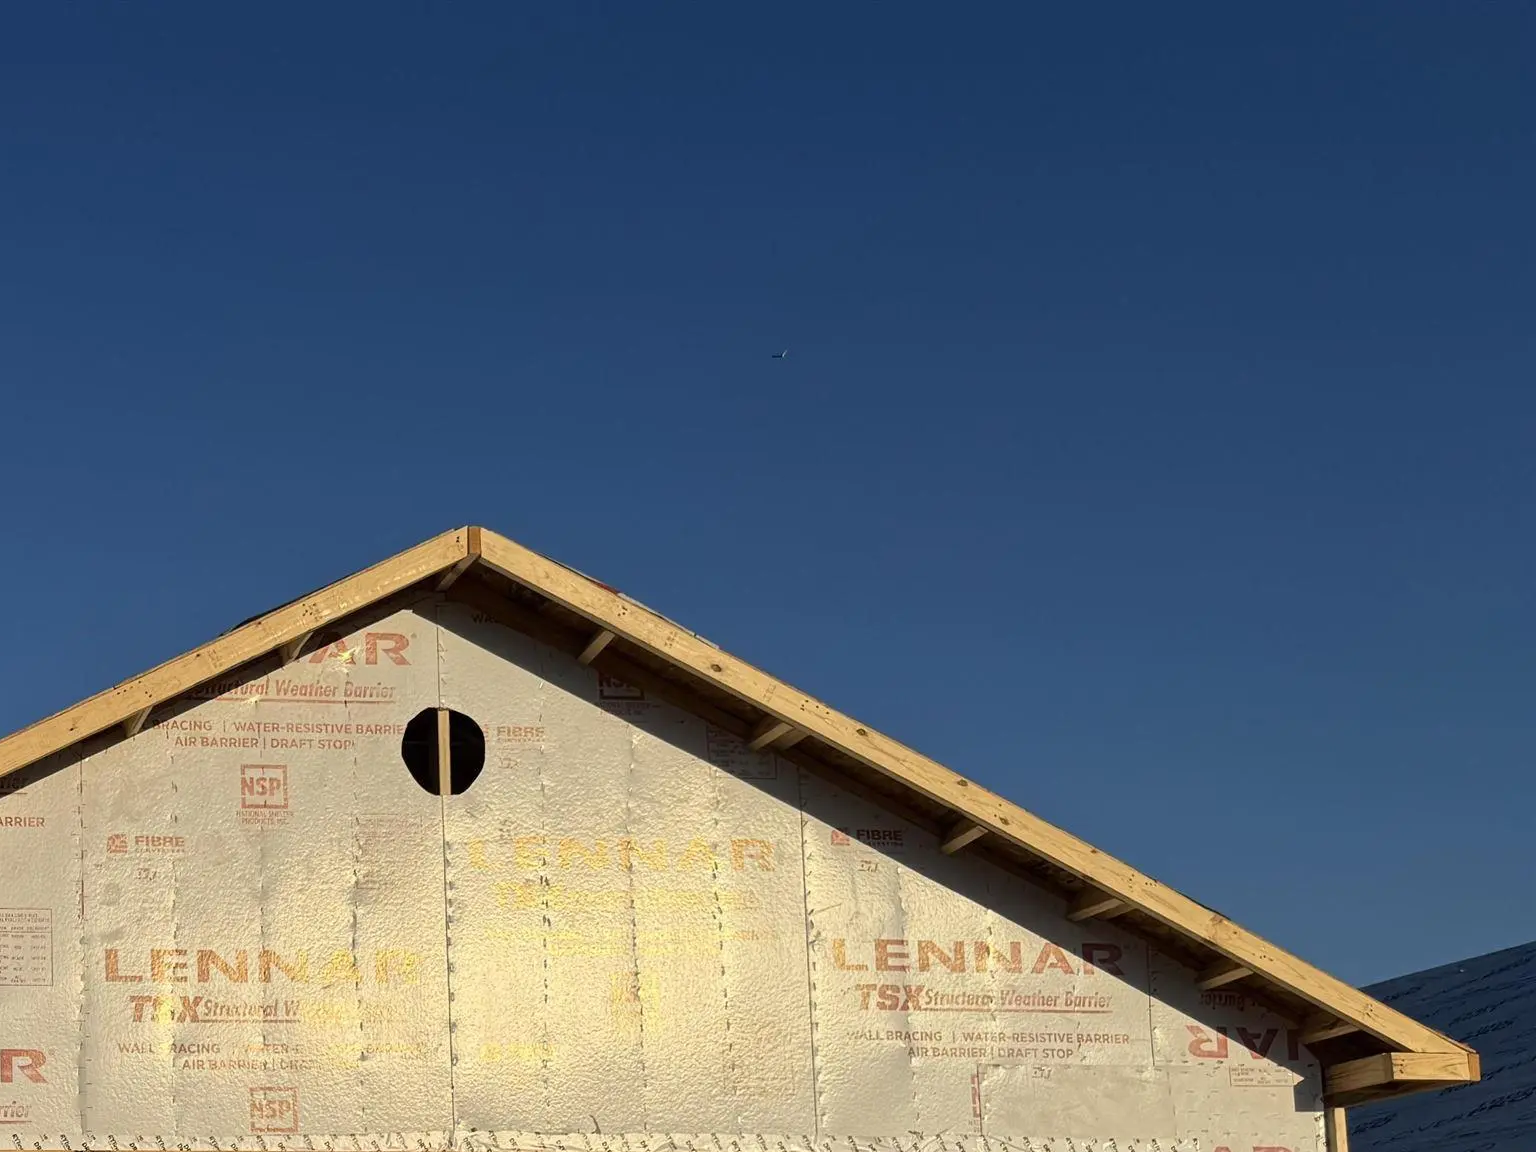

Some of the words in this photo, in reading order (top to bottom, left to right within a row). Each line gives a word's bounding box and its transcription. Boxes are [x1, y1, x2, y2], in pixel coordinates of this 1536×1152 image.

[275, 680, 337, 698] Weather
[343, 682, 396, 698] Barrier
[233, 722, 352, 734] WATER-RESISTIVE
[174, 736, 197, 748] AIR
[200, 737, 259, 748] BARRIER
[270, 738, 313, 749] DRAFT
[317, 738, 352, 750] STOP
[240, 776, 281, 796] NSP
[856, 829, 903, 842] FIBRE
[832, 938, 1125, 976] LENNAR
[104, 949, 420, 984] LENNAR
[859, 984, 925, 1012] TSX
[1000, 990, 1060, 1009] Weather
[1064, 992, 1113, 1010] Barrier
[886, 1031, 943, 1042] BRACING
[962, 1031, 1073, 1044] WATER-RESISTIVE
[1076, 1033, 1130, 1045] BARRIER
[907, 1047, 929, 1058] AIR
[930, 1047, 988, 1058] BARRIER
[996, 1048, 1038, 1058] DRAFT
[1042, 1048, 1074, 1059] STOP
[182, 1059, 206, 1070] AIR
[250, 1101, 291, 1118] NSP
